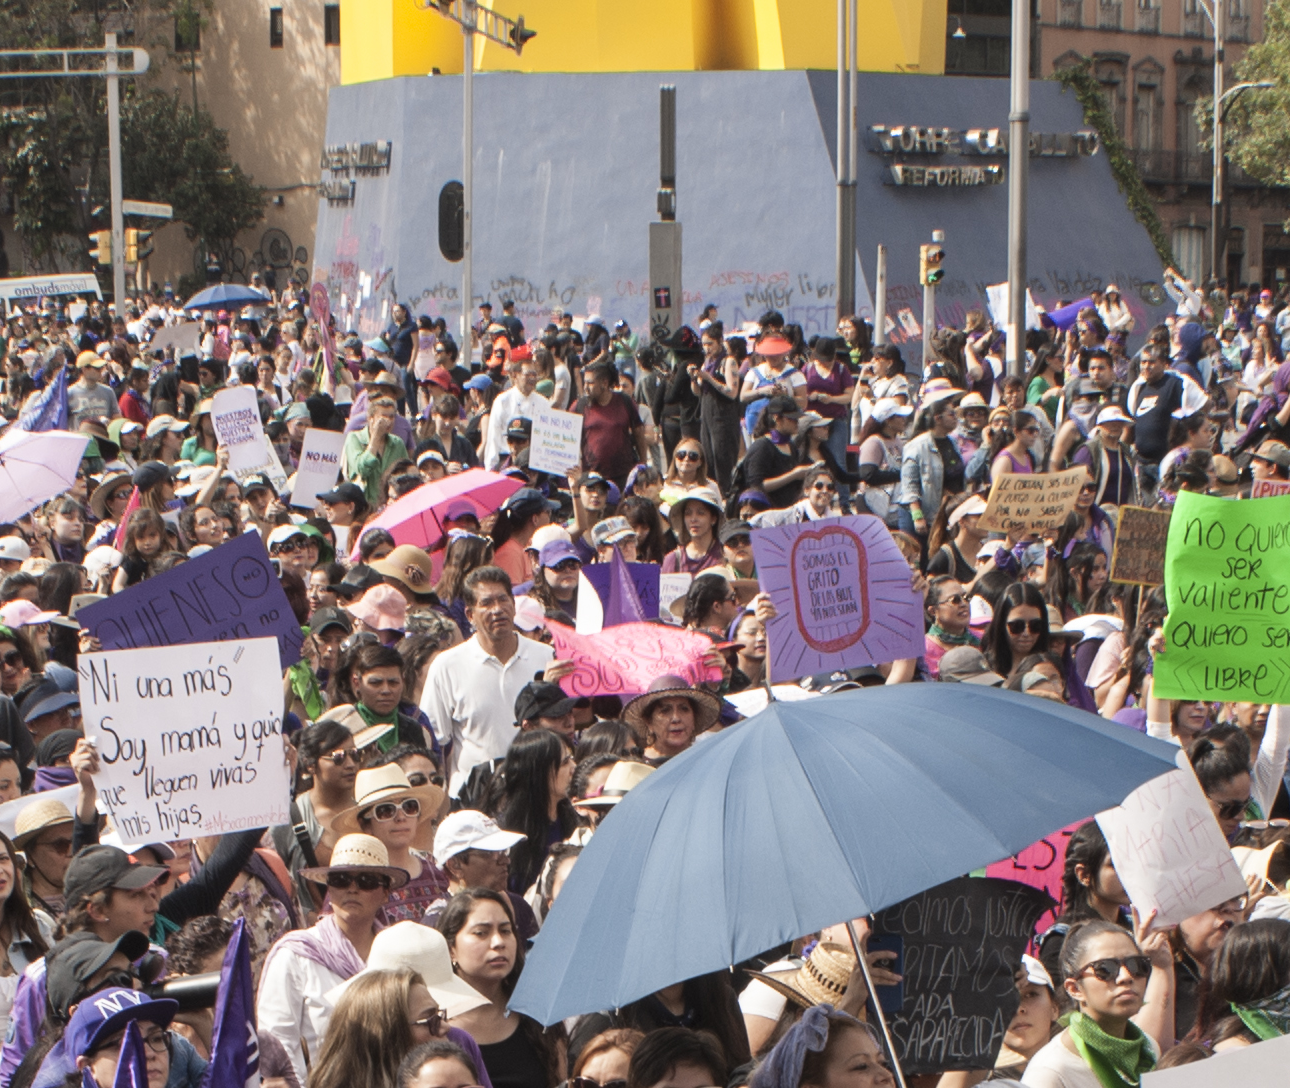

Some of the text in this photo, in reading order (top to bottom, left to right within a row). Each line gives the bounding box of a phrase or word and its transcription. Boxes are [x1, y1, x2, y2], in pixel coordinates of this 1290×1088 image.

[305, 452, 338, 464] NO MÁS
[995, 505, 1011, 517] POR
[1016, 507, 1031, 517] NO
[1184, 516, 1226, 551] no
[802, 551, 854, 571] SOMOS EL
[808, 567, 840, 591] GRITO
[1178, 582, 1290, 616] valiente
[259, 609, 281, 628] no
[136, 675, 174, 700] una
[99, 711, 249, 776] Soy mamá y
[99, 761, 258, 829] que lleguen vivas
[122, 812, 152, 840] mis
